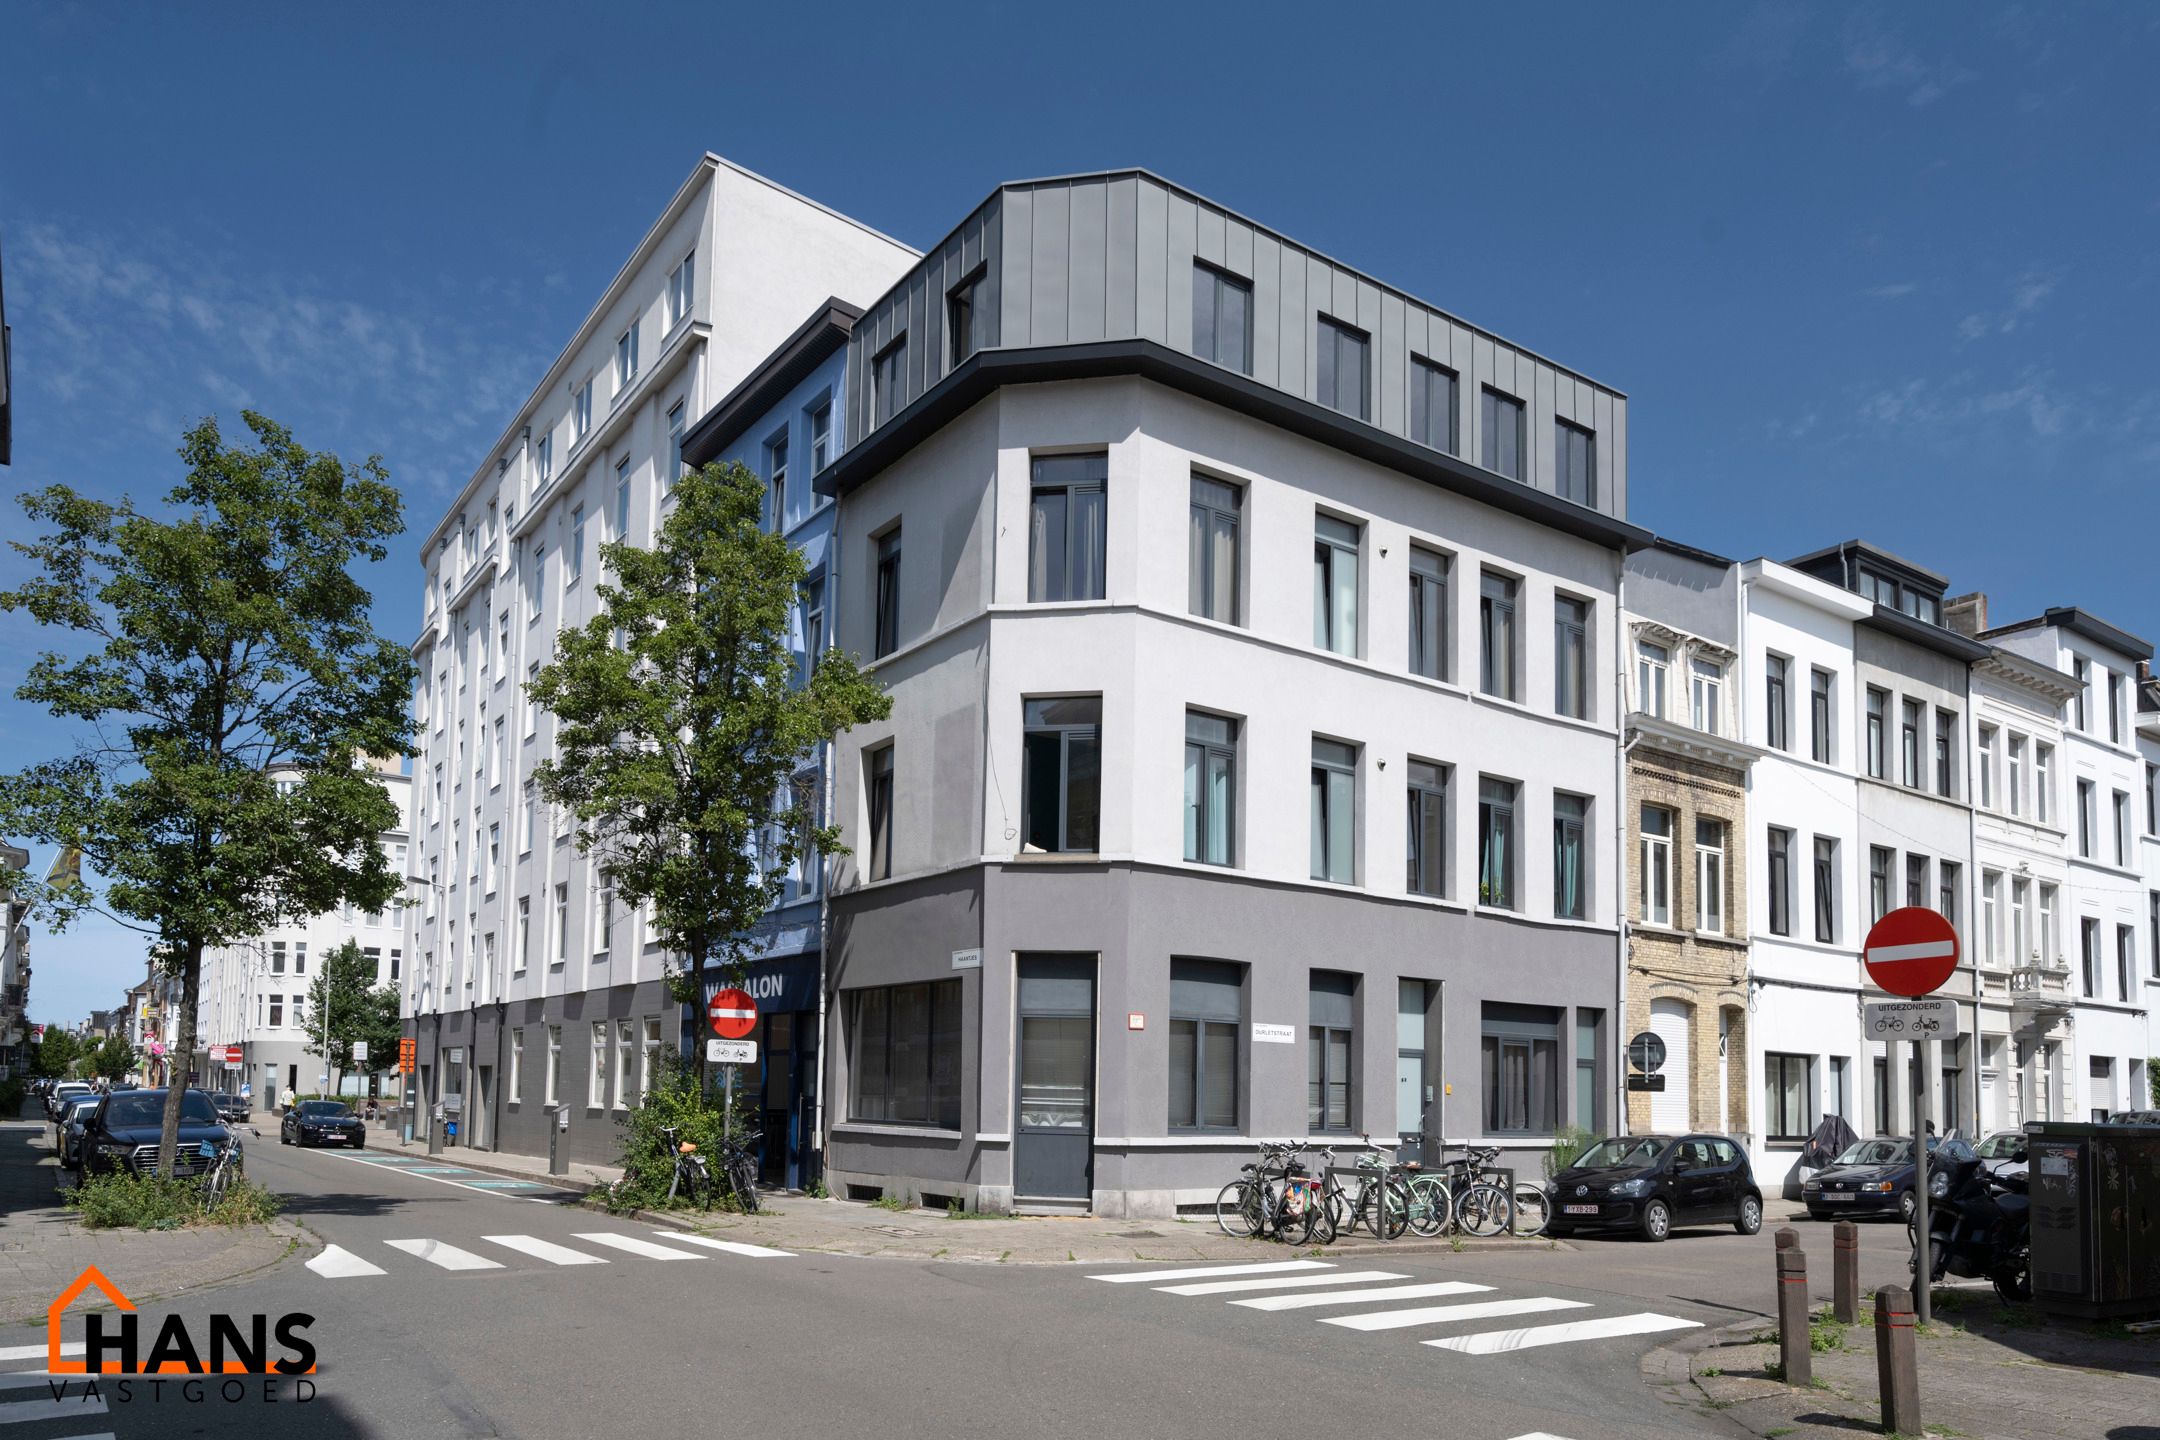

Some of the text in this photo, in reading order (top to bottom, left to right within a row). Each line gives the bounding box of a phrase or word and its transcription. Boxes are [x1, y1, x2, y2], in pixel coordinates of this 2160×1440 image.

[705, 973, 783, 1004] WALON
[1878, 1003, 1942, 1012] UITGEZONDERD
[1255, 1029, 1292, 1037] DURLETSTRAAT
